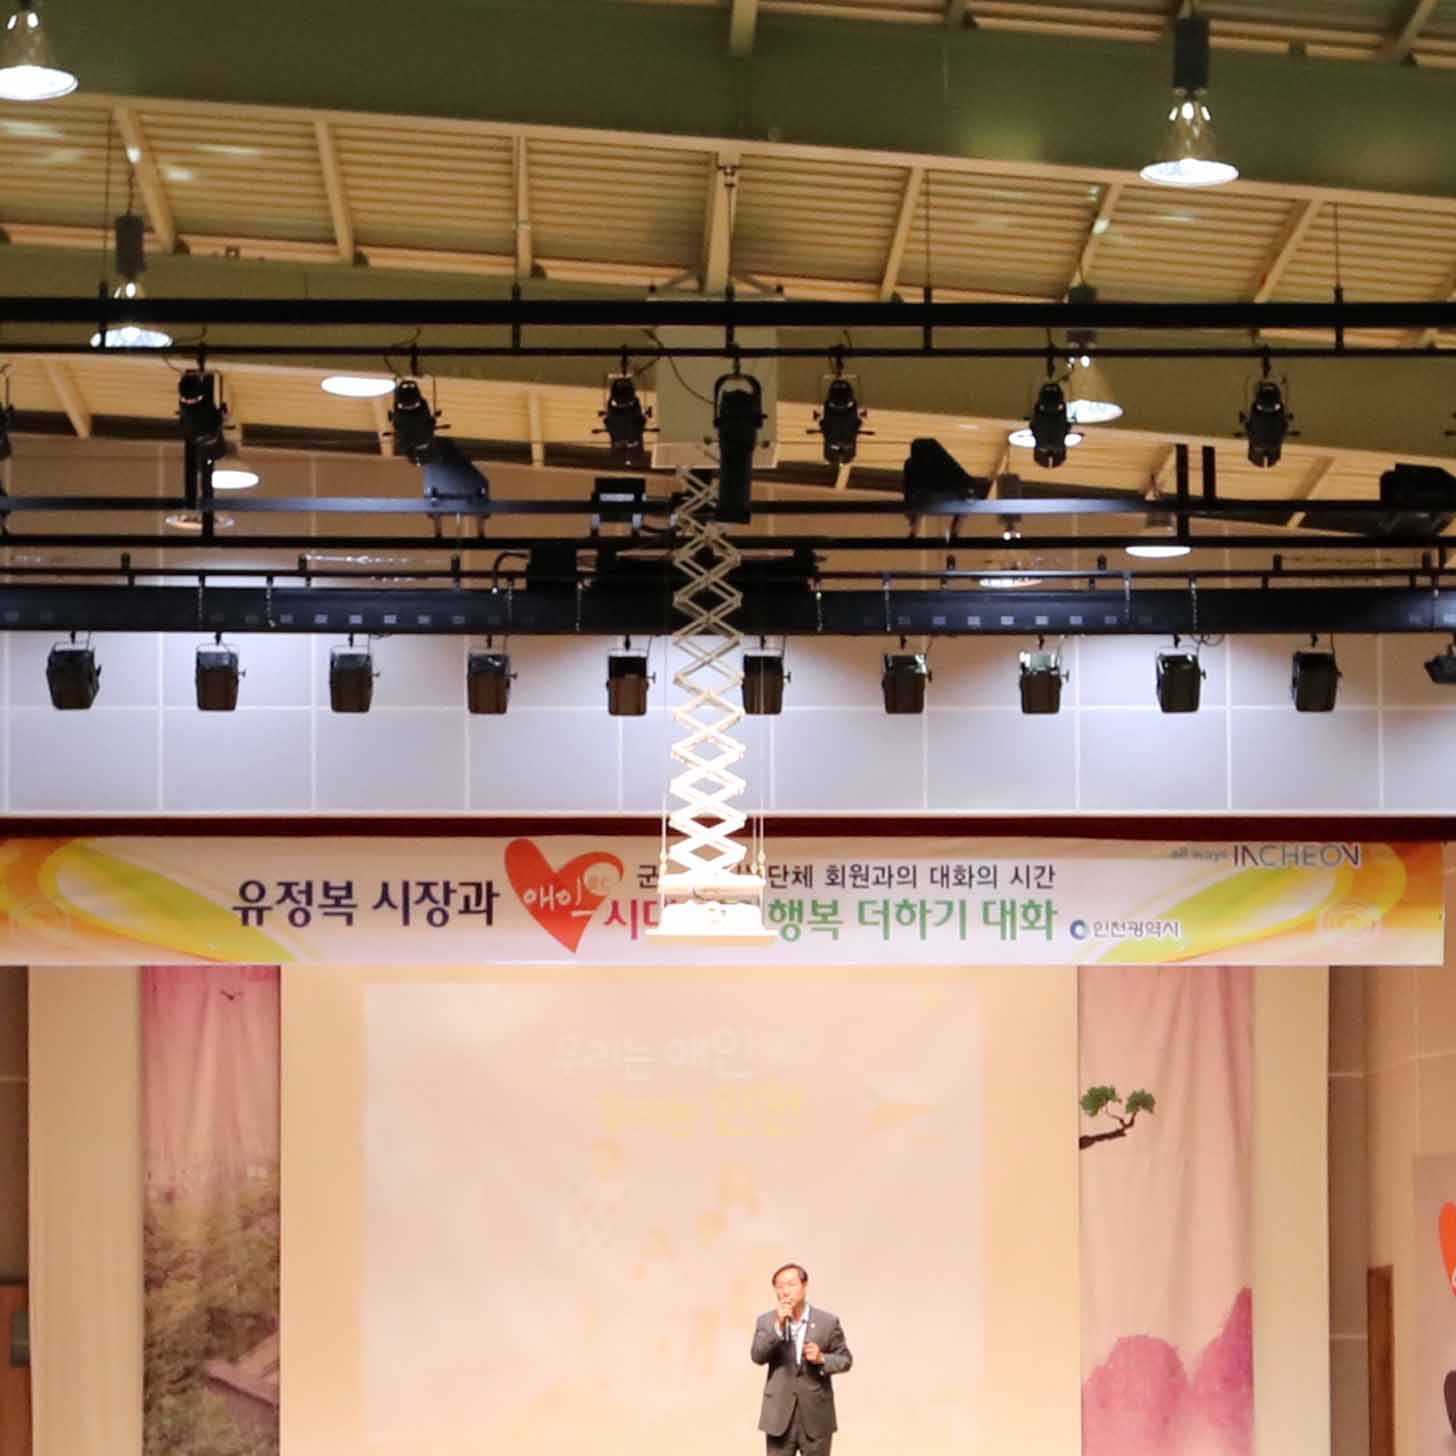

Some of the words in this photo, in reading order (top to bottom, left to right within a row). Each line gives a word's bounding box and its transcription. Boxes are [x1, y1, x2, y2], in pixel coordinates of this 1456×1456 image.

[1233, 844, 1360, 867] INCHEON
[825, 864, 918, 889] 회원과의
[930, 864, 999, 889] 대화의
[1010, 864, 1057, 889] 시간
[232, 880, 358, 928] 유정복
[372, 880, 501, 928] 시장과
[768, 898, 844, 943] 행복
[857, 898, 967, 941] 더하기
[981, 898, 1059, 941] 대화
[1093, 920, 1179, 938] 인천광역시
